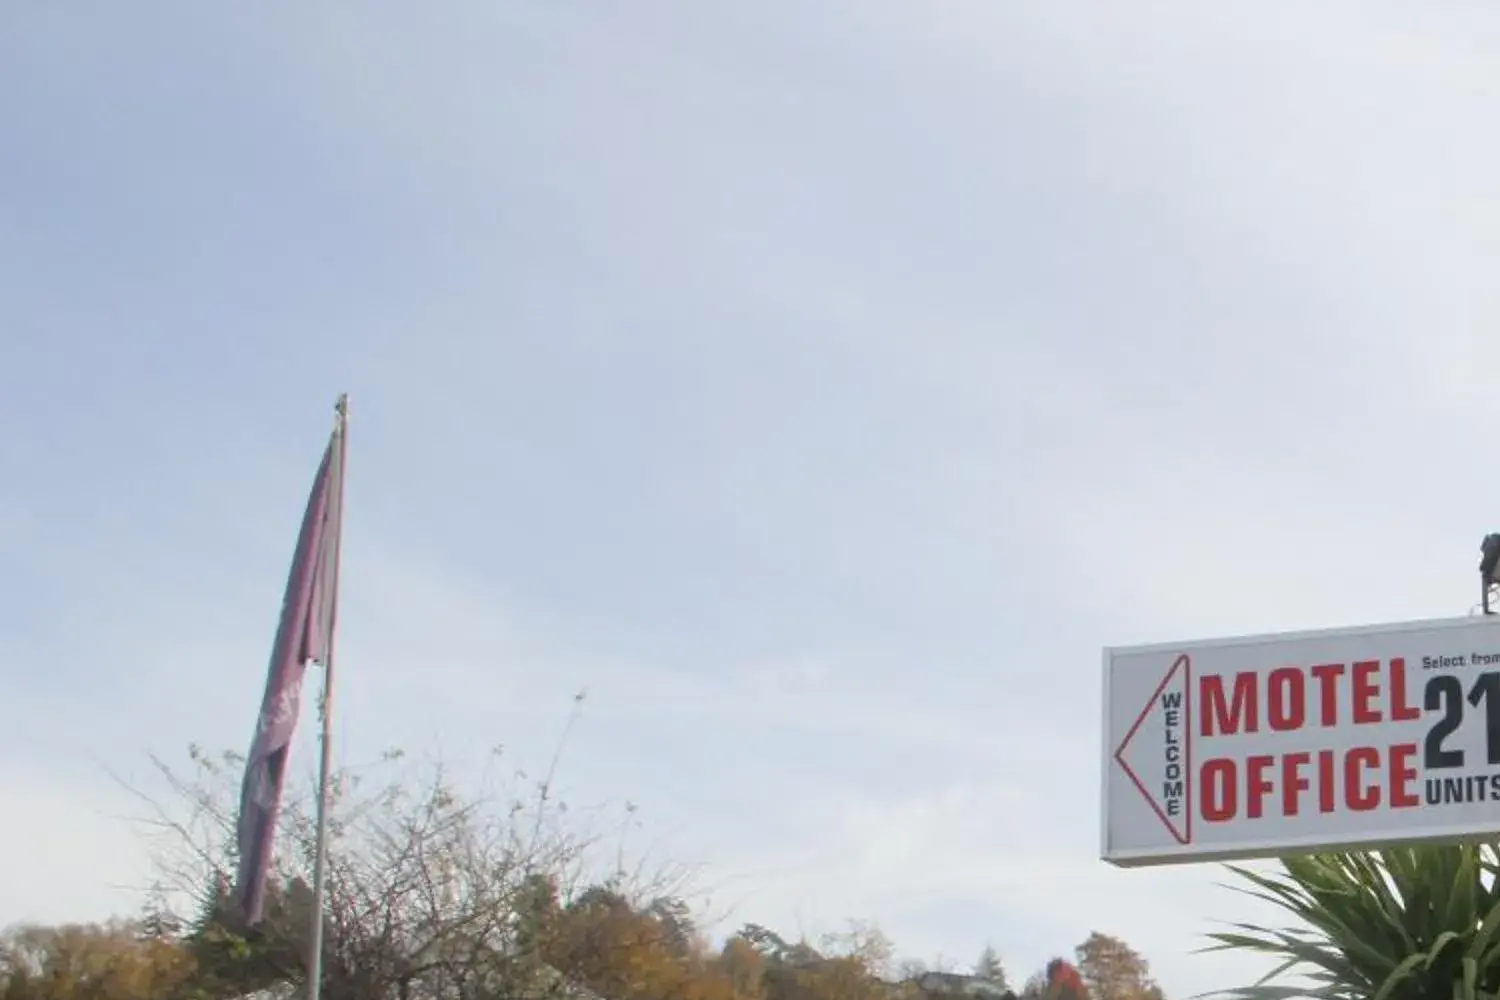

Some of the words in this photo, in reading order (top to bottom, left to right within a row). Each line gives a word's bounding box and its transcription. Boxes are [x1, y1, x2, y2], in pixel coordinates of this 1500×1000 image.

[1200, 657, 1420, 737] MOTEL
[1422, 655, 1466, 669] Select
[1162, 692, 1182, 816] WELCOME
[1200, 743, 1420, 822] OFFICE
